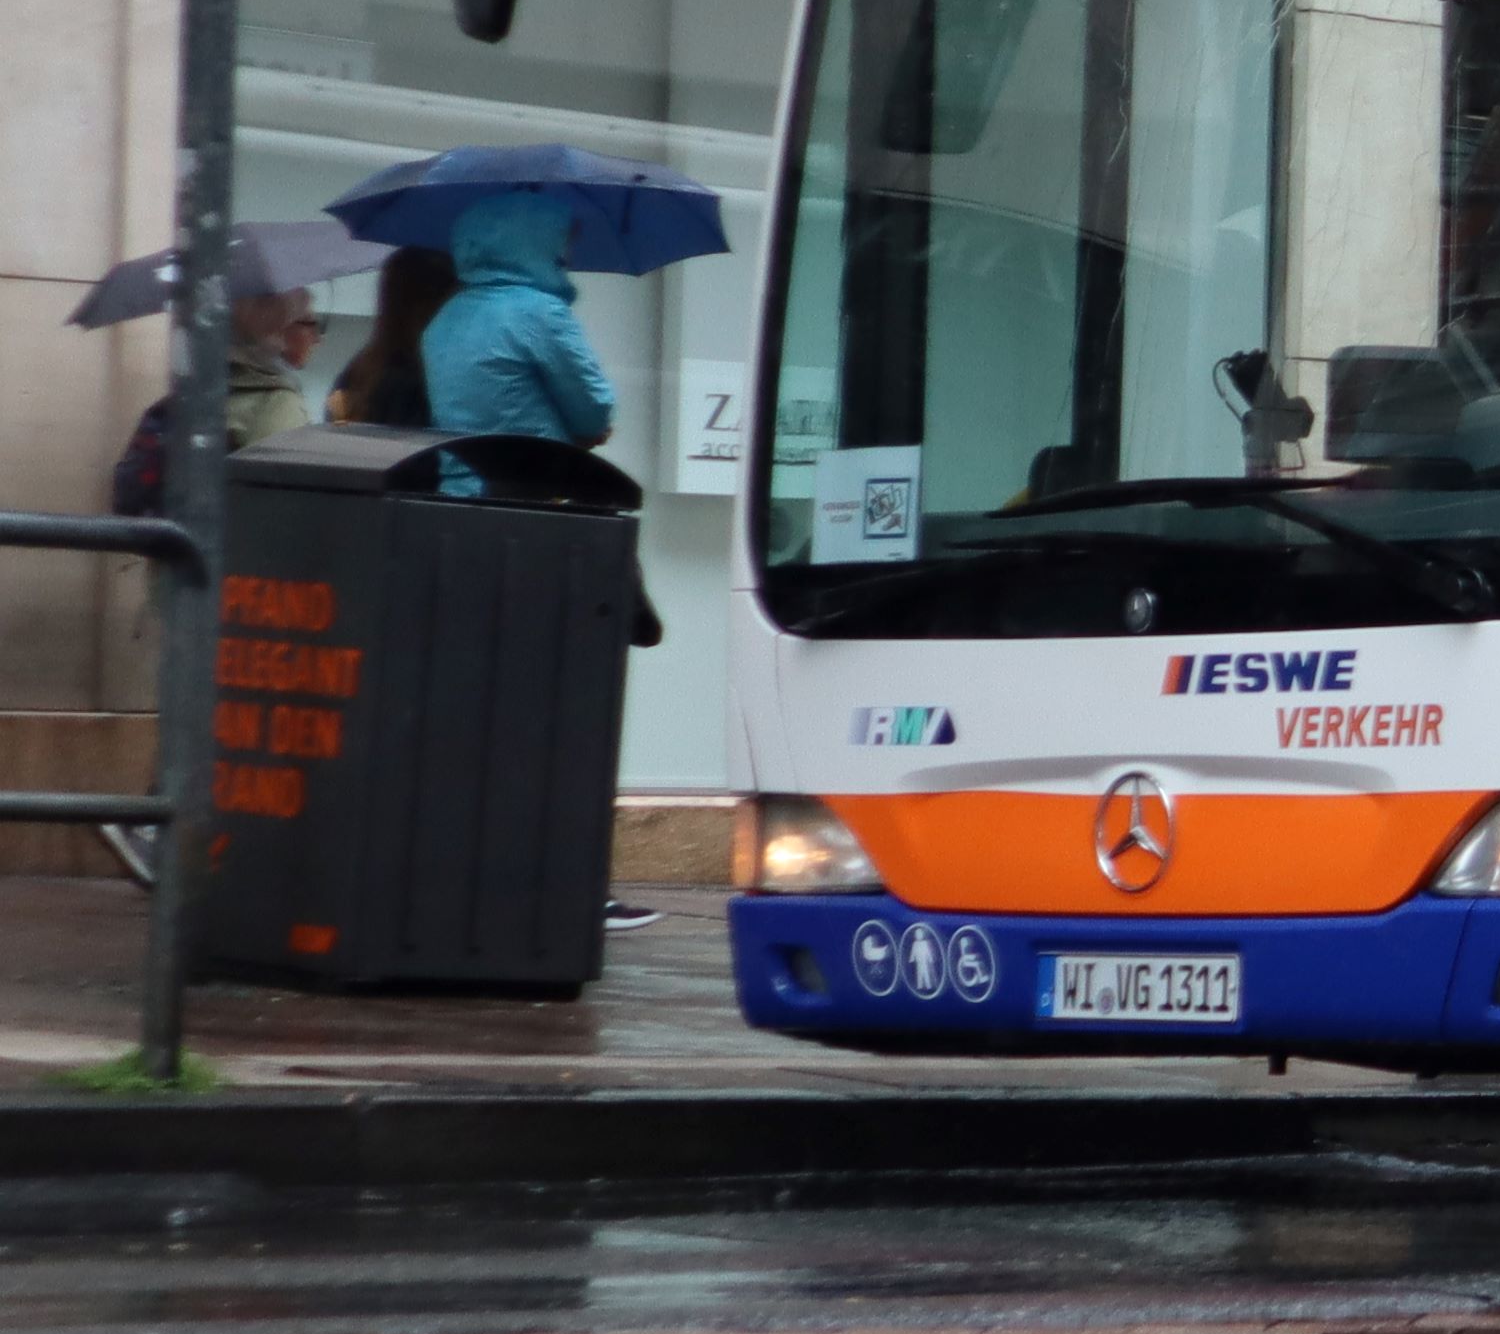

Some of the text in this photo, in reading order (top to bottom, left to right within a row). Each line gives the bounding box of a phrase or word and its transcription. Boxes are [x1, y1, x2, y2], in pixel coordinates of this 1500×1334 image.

[221, 575, 334, 632] PFAND
[214, 637, 363, 699] ELEGANT
[1188, 648, 1361, 694] ESWE
[268, 703, 344, 759] DEN
[862, 706, 952, 746] RMV
[1275, 703, 1445, 750] VERKEHR
[1062, 962, 1096, 1011] WI
[1116, 963, 1152, 1012] VG
[1157, 964, 1230, 1014] 1311
